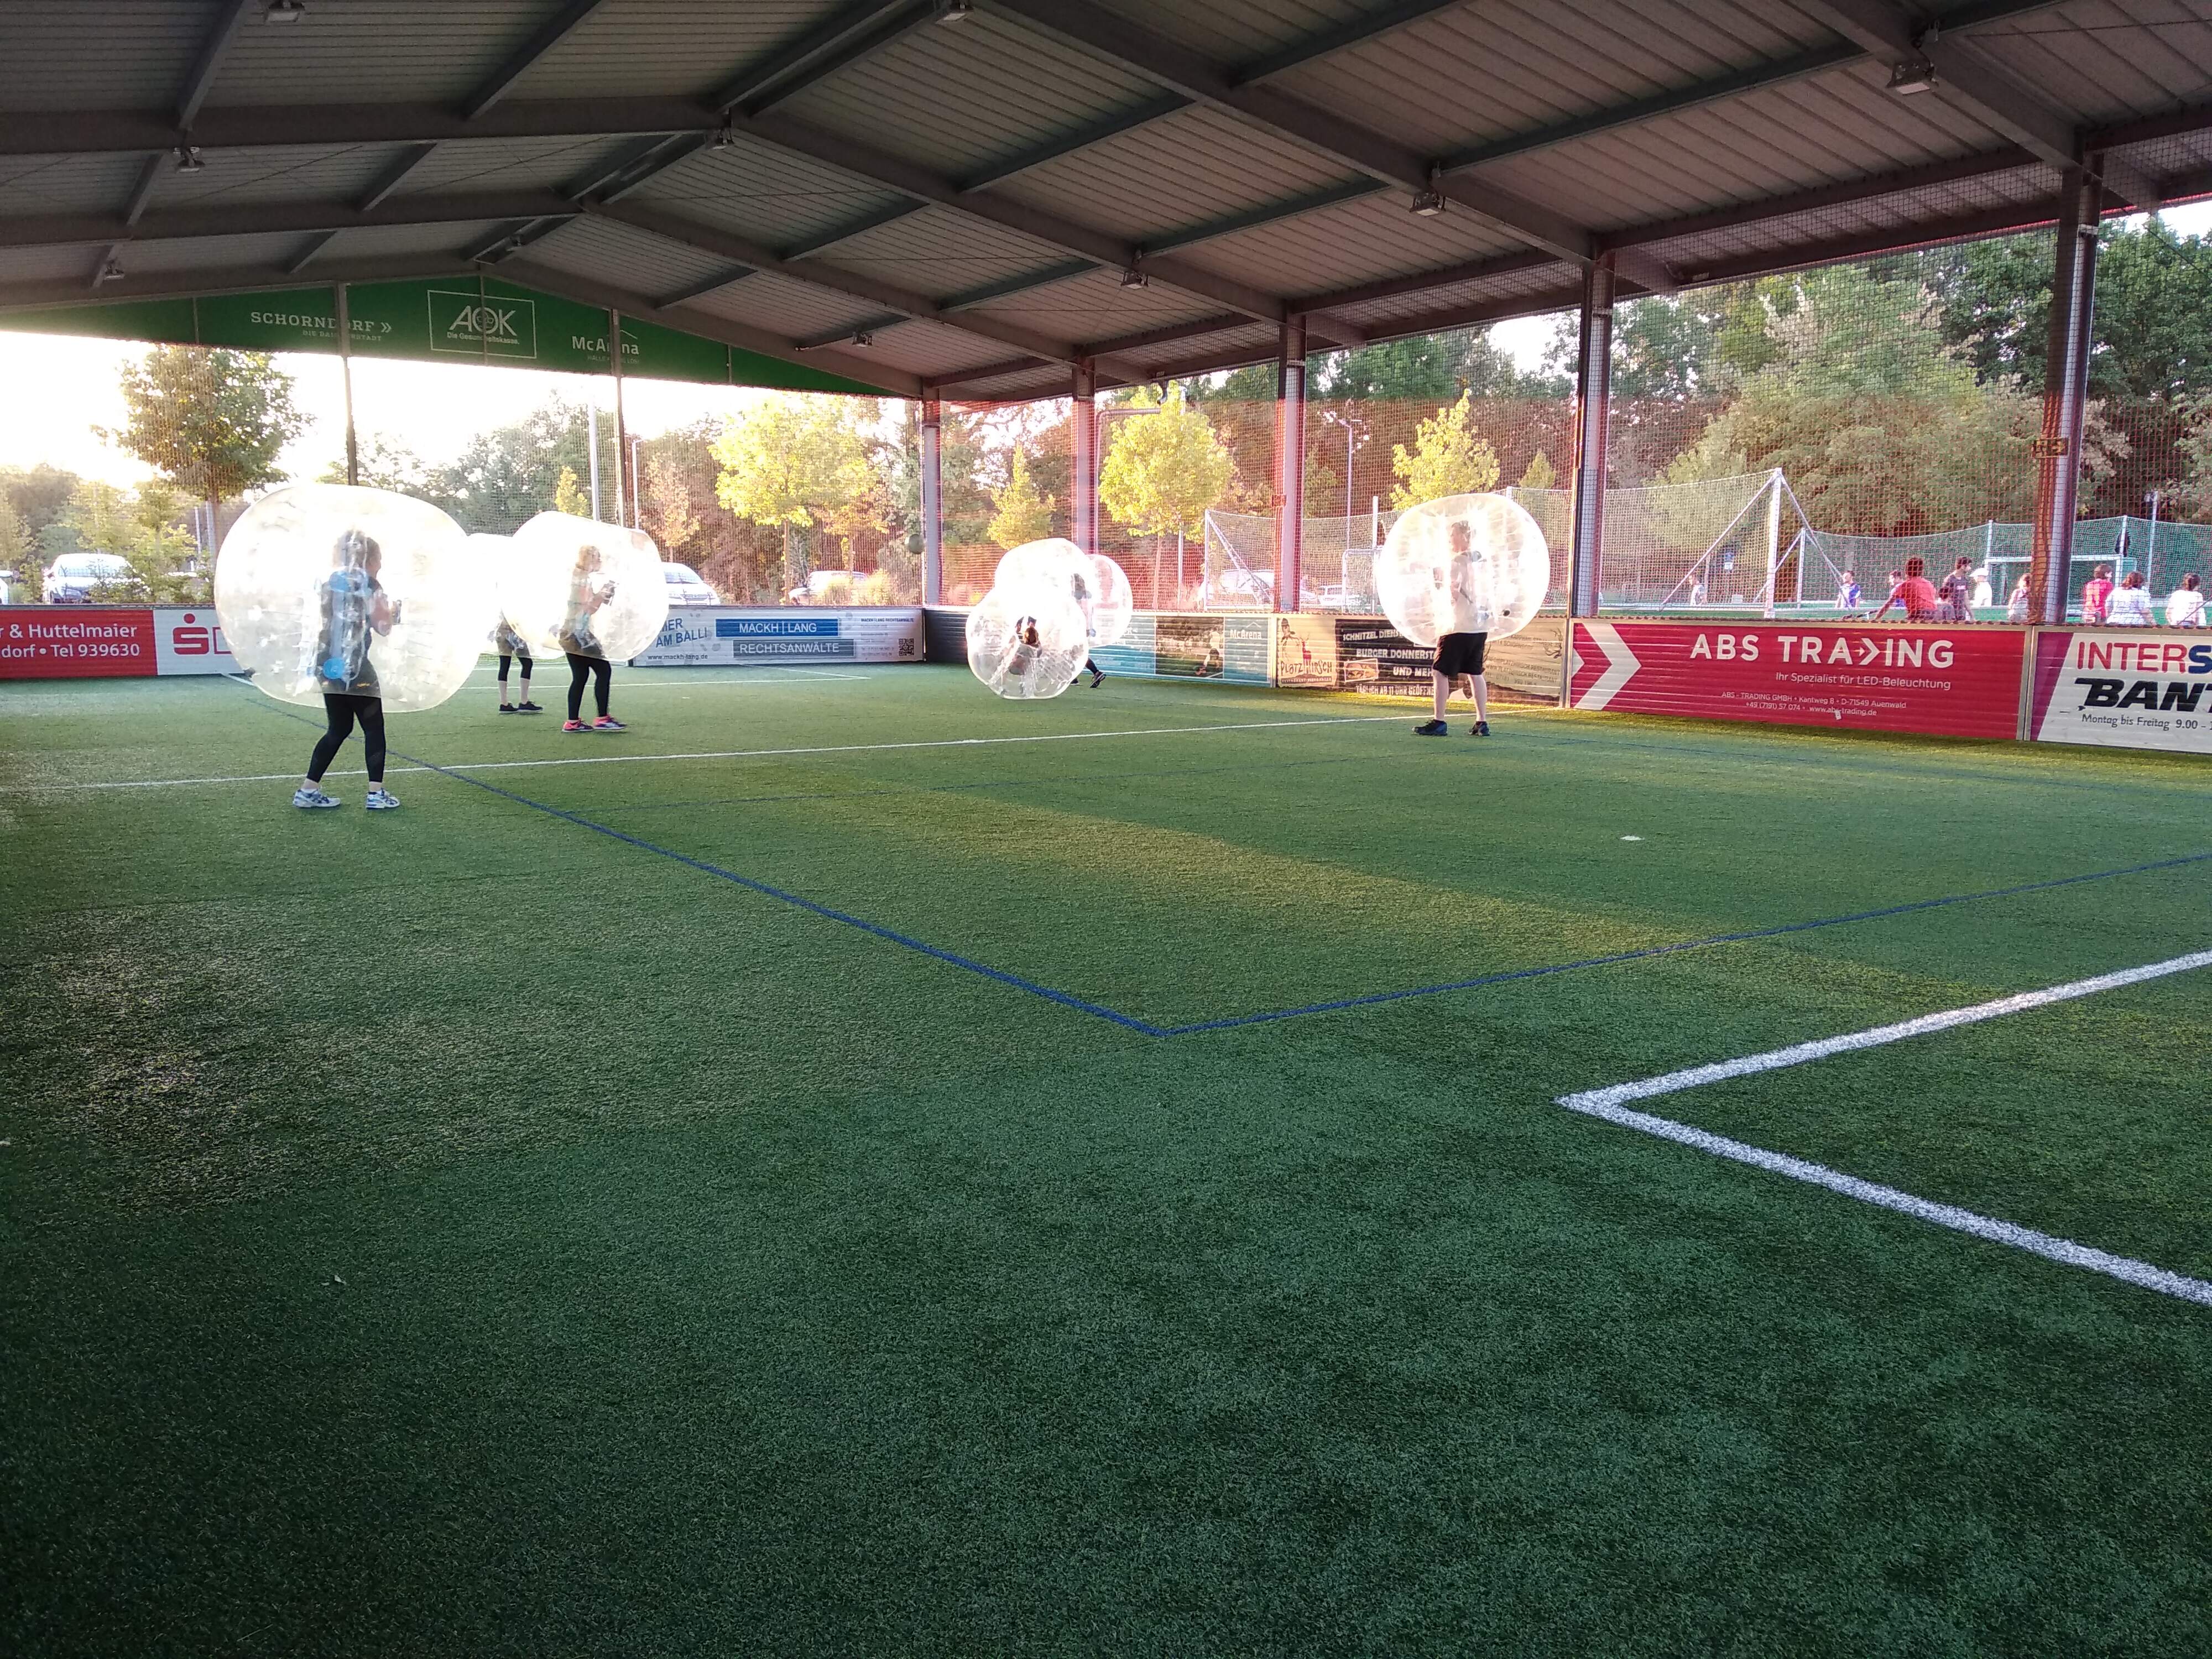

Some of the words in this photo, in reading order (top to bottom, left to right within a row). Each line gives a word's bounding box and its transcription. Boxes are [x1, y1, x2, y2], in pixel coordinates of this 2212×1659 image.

[251, 311, 374, 332] SCHORNDRF
[448, 305, 518, 336] AOK
[572, 336, 639, 355] McAna
[9, 624, 23, 638] &
[29, 623, 138, 638] Huttelmaier
[739, 623, 779, 633] MACKH
[787, 623, 817, 633] LANG
[1230, 629, 1262, 640] McArena
[656, 634, 672, 648] AM
[1343, 632, 1378, 641] SCHNITZEL
[1, 644, 35, 658] dorf
[50, 644, 74, 658] Tel
[78, 644, 140, 657] 939630
[740, 641, 840, 654] RECHTSANWÄLTE
[1356, 648, 1388, 659] BURGER
[1390, 649, 1437, 660] DONNERST
[1690, 634, 1760, 661] ABS
[1393, 666, 1412, 676] UND
[1776, 672, 1788, 682] Ihr
[1791, 672, 1837, 685] Spezialist
[1840, 675, 1854, 685] für
[1857, 676, 1951, 691] LED-Beleuchtung
[1389, 686, 1394, 695] 11
[1741, 692, 1771, 701] TRADING
[1799, 696, 1828, 705] Kantweg
[1759, 702, 1777, 710] (7191)
[2081, 713, 2117, 728] Montag
[2121, 714, 2133, 726] bis
[2137, 717, 2169, 731] Freitag
[2176, 719, 2198, 730] 9.00
